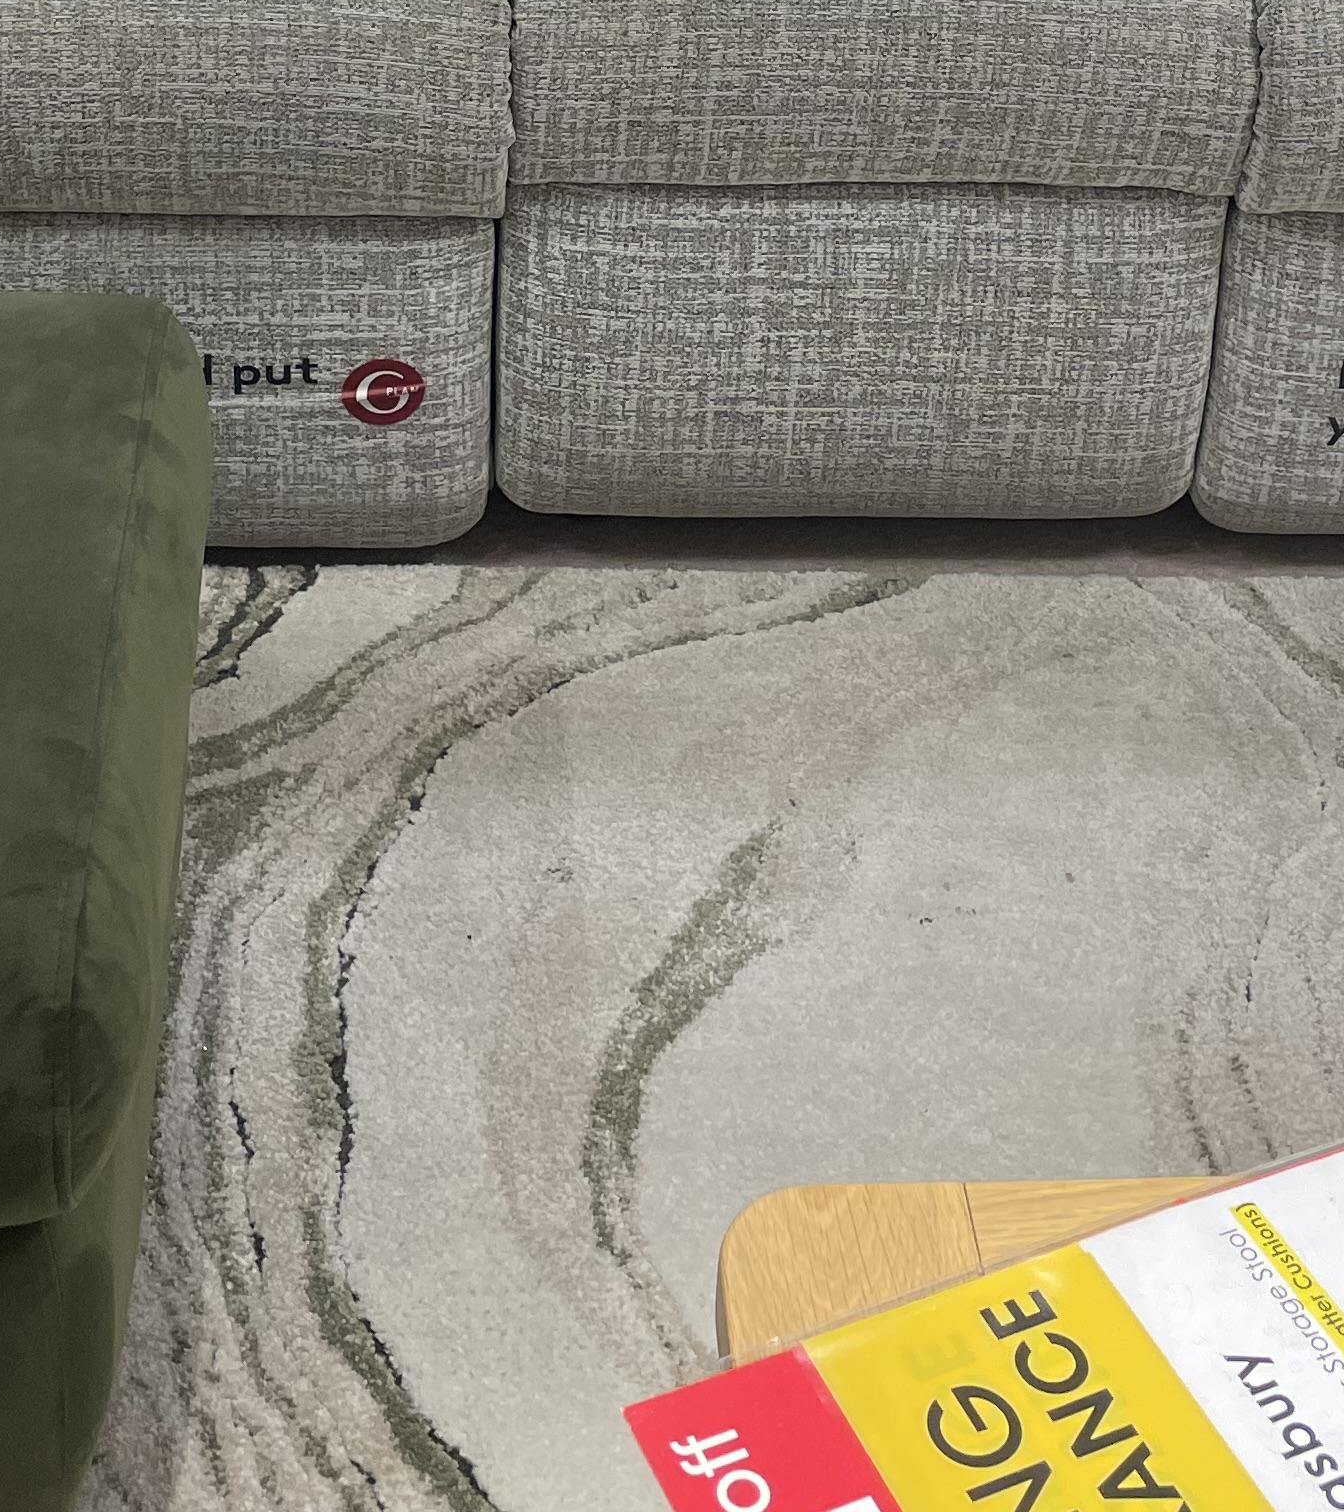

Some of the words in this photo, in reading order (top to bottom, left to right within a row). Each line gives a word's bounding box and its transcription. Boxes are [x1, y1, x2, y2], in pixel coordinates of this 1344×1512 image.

[233, 357, 319, 394] put
[1219, 1228, 1273, 1283] Stool
[1235, 1201, 1314, 1291] Cushions)
[979, 1289, 1200, 1512] ANCE
